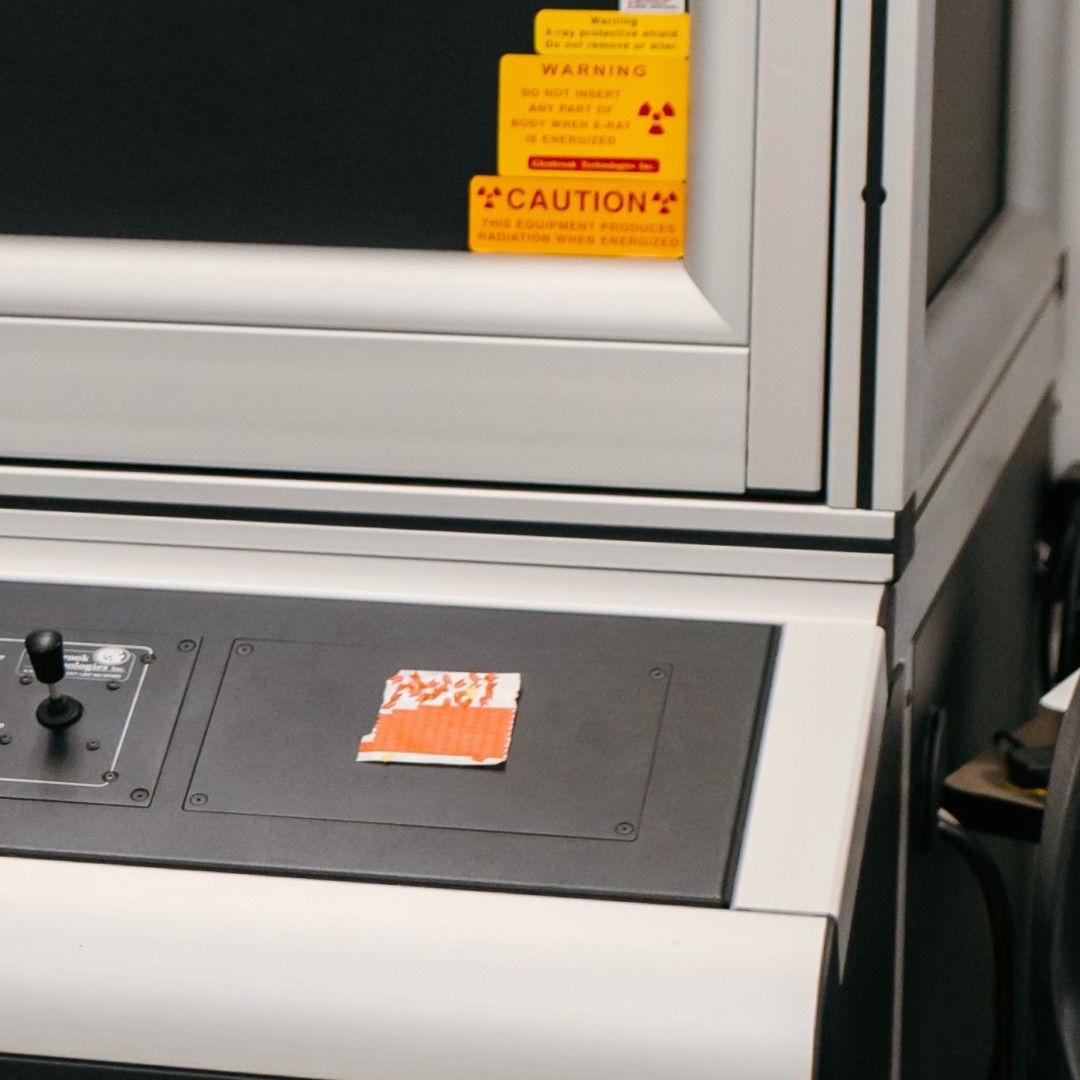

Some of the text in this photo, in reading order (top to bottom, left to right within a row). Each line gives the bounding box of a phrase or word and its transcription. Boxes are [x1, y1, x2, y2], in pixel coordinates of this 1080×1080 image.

[588, 40, 630, 50] remove
[542, 63, 647, 77] WARNING
[522, 88, 621, 98] DO NOT INSERT
[528, 104, 614, 113] ANY PART OF
[511, 119, 631, 129] BODY WHEN X-RAY
[526, 135, 616, 145] IS ENERGIZED
[507, 188, 646, 212] CAUTION
[482, 219, 676, 233] THIS EQUIPMENT PRODUCES
[478, 232, 679, 247] RADIATION WHEN ENERGIZED
